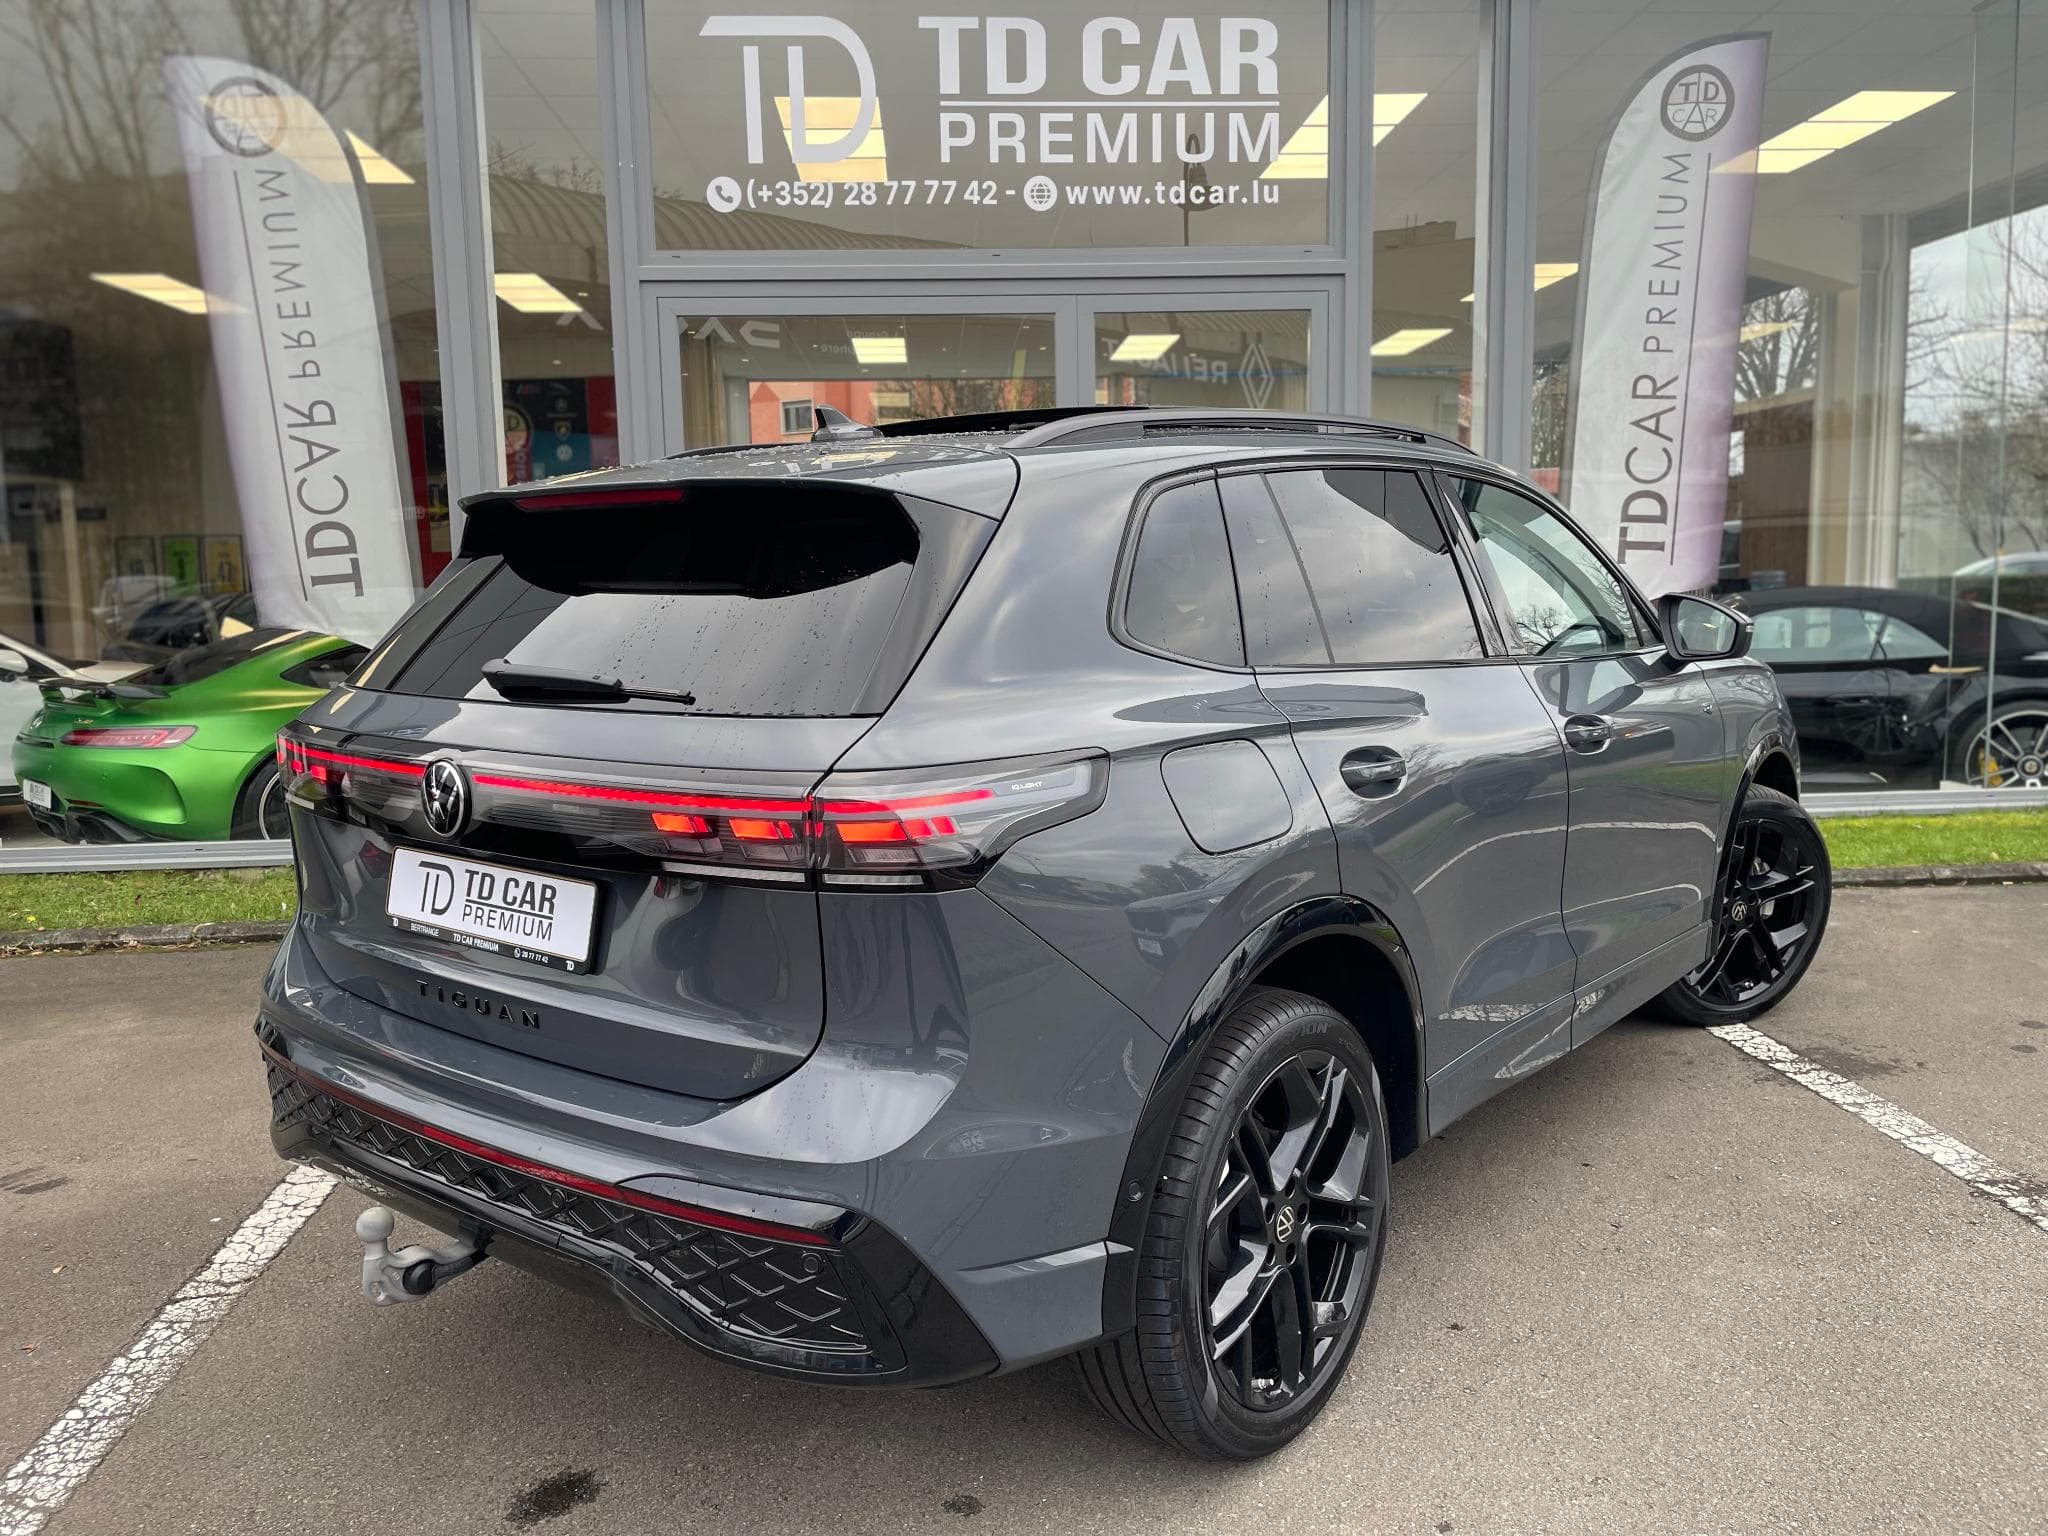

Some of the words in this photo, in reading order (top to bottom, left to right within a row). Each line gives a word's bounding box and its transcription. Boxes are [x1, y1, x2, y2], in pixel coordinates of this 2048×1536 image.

[918, 16, 1047, 95] TD
[1082, 16, 1279, 95] CAR
[1678, 80, 1720, 102] TD
[939, 112, 1280, 164] PREMIUM
[747, 178, 834, 209] (+352)
[843, 181, 877, 206] 28
[883, 180, 917, 205] 77
[924, 180, 957, 205] 77
[963, 179, 998, 205] 42
[1065, 180, 1280, 205] www.tdcar.lu
[1643, 153, 1692, 353] PREMIUM
[1617, 374, 1679, 565] TDCAR
[464, 868, 496, 902] TD
[502, 877, 558, 915] CAR
[410, 923, 440, 937] BERTRANGE
[453, 933, 461, 943] TD
[461, 935, 473, 946] CAR
[473, 938, 499, 953] PREMIUM
[462, 904, 553, 942] PREMIUM
[416, 979, 540, 1030] TIGUAN
